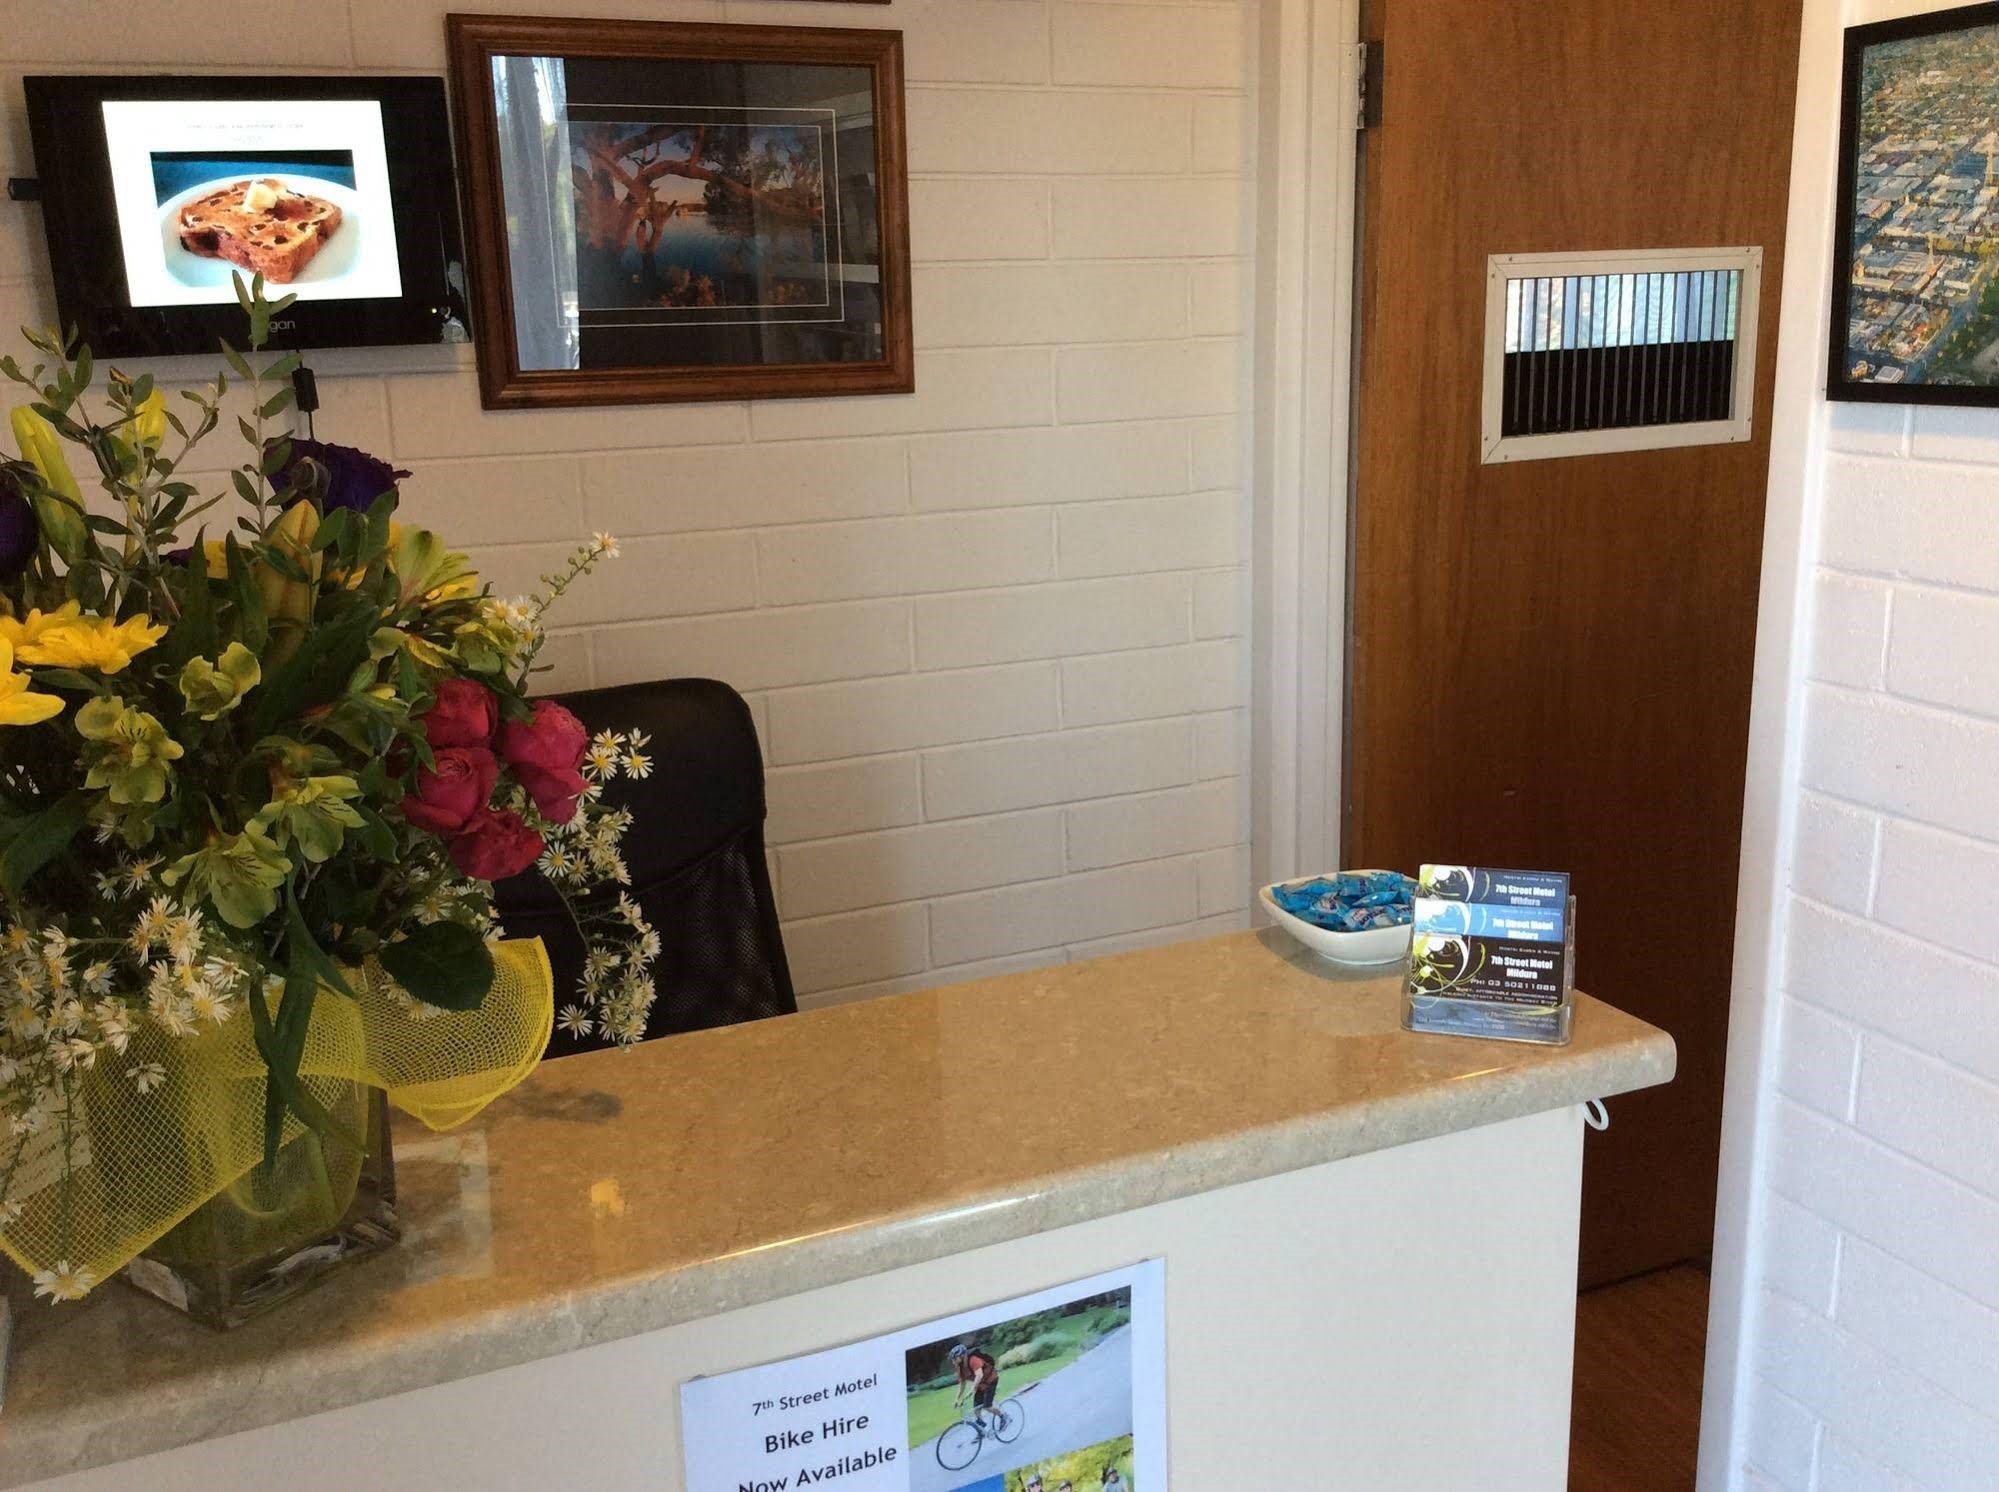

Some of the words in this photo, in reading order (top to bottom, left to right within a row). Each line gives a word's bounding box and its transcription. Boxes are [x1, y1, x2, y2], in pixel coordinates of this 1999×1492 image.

[269, 320, 296, 333] gan
[1495, 884, 1507, 894] 7th
[1508, 885, 1532, 895] Street
[1533, 887, 1556, 897] Motel
[1491, 955, 1503, 965] 7th
[1504, 956, 1529, 967] Street
[1529, 958, 1553, 969] Motel
[1506, 968, 1538, 979] Mildura
[752, 1399, 774, 1416] 7th
[779, 1389, 829, 1411] Street
[834, 1373, 878, 1397] Motel
[765, 1430, 814, 1453] Bike
[822, 1415, 869, 1439] Hire
[796, 1447, 897, 1487] Available
